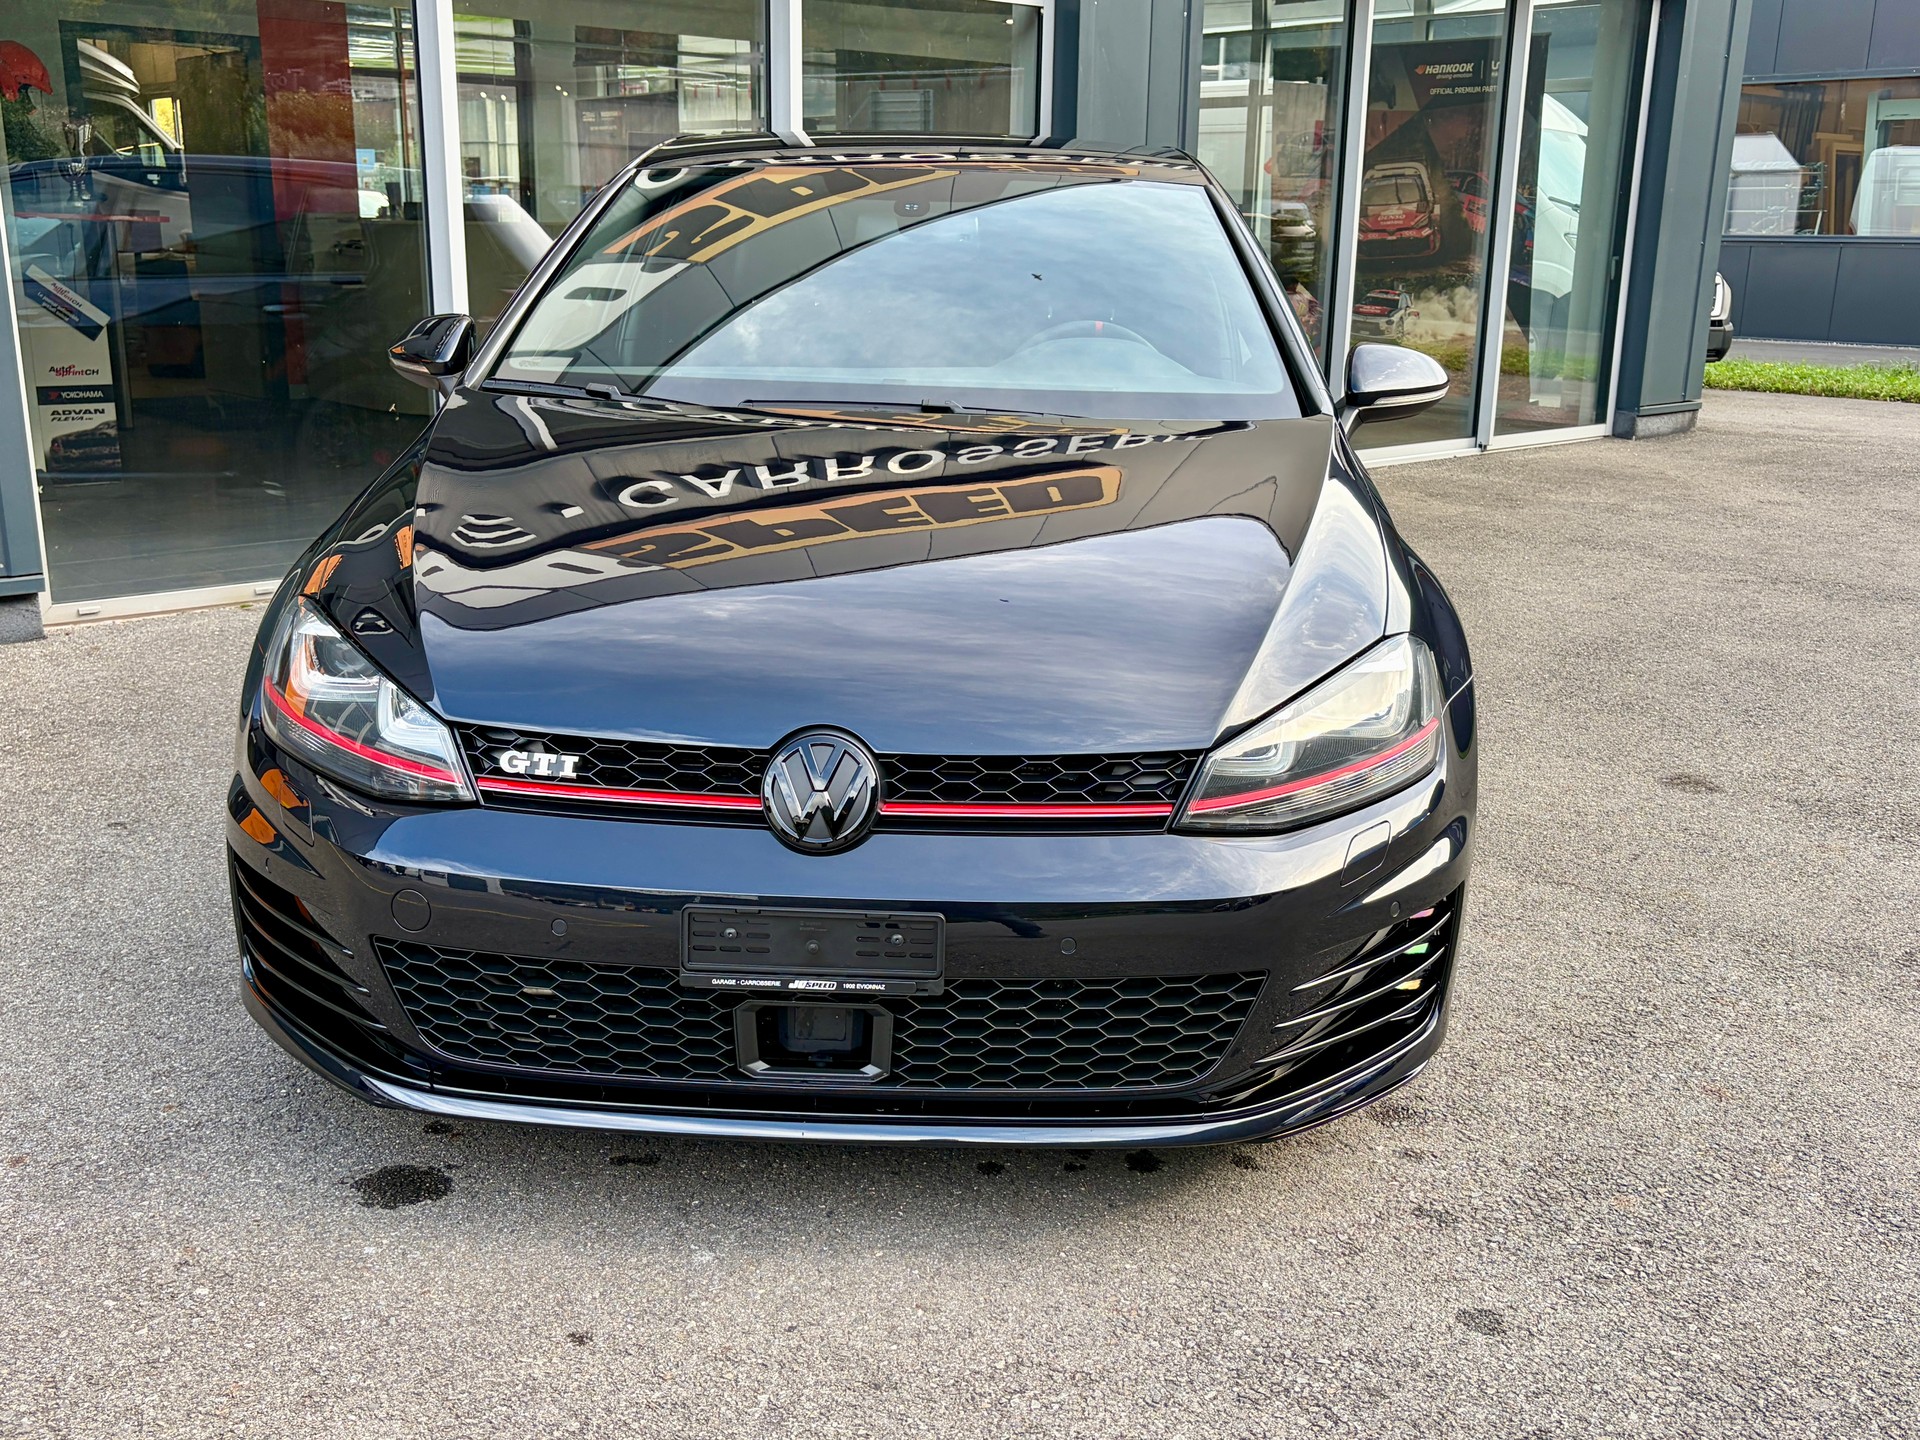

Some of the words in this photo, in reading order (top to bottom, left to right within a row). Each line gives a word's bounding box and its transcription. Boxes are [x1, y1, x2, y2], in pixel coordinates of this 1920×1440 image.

[1429, 87, 1454, 95] OFFICIAL
[1454, 86, 1481, 94] PREMIUM
[60, 390, 104, 399] YOKOHAMA
[50, 408, 106, 416] ADVAN
[499, 750, 580, 779] GTI
[711, 978, 737, 986] GARAGE
[740, 979, 781, 987] CARROSSERIE
